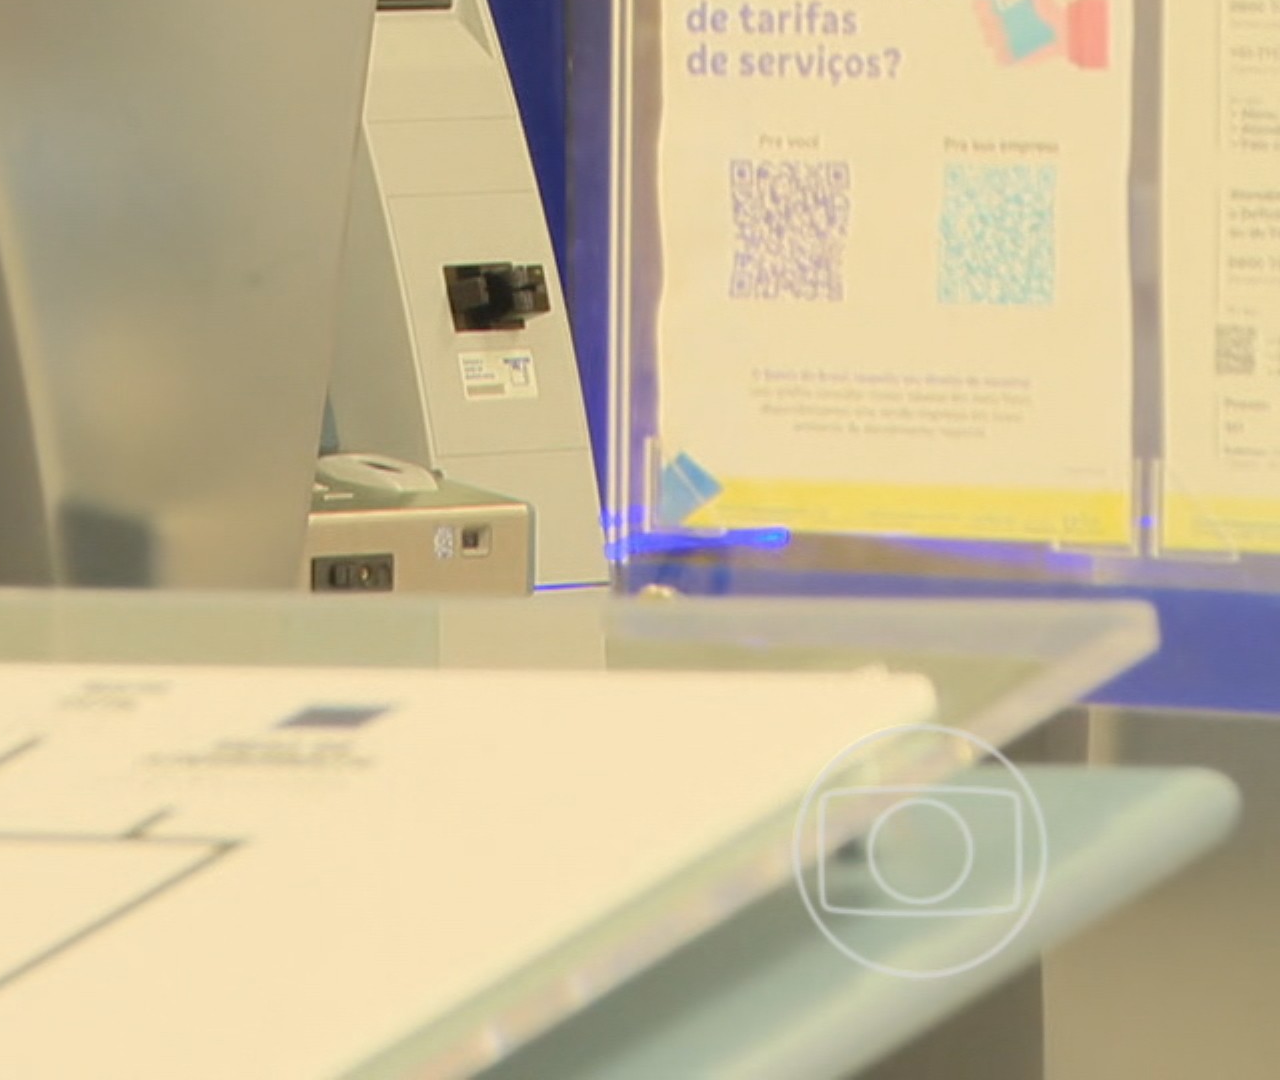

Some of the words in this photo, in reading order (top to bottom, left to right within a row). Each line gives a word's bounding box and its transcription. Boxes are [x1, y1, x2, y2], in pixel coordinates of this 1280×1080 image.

[686, 0, 728, 34] de
[740, 1, 858, 35] tarifas
[686, 42, 728, 76] de
[740, 44, 902, 87] serviços?
